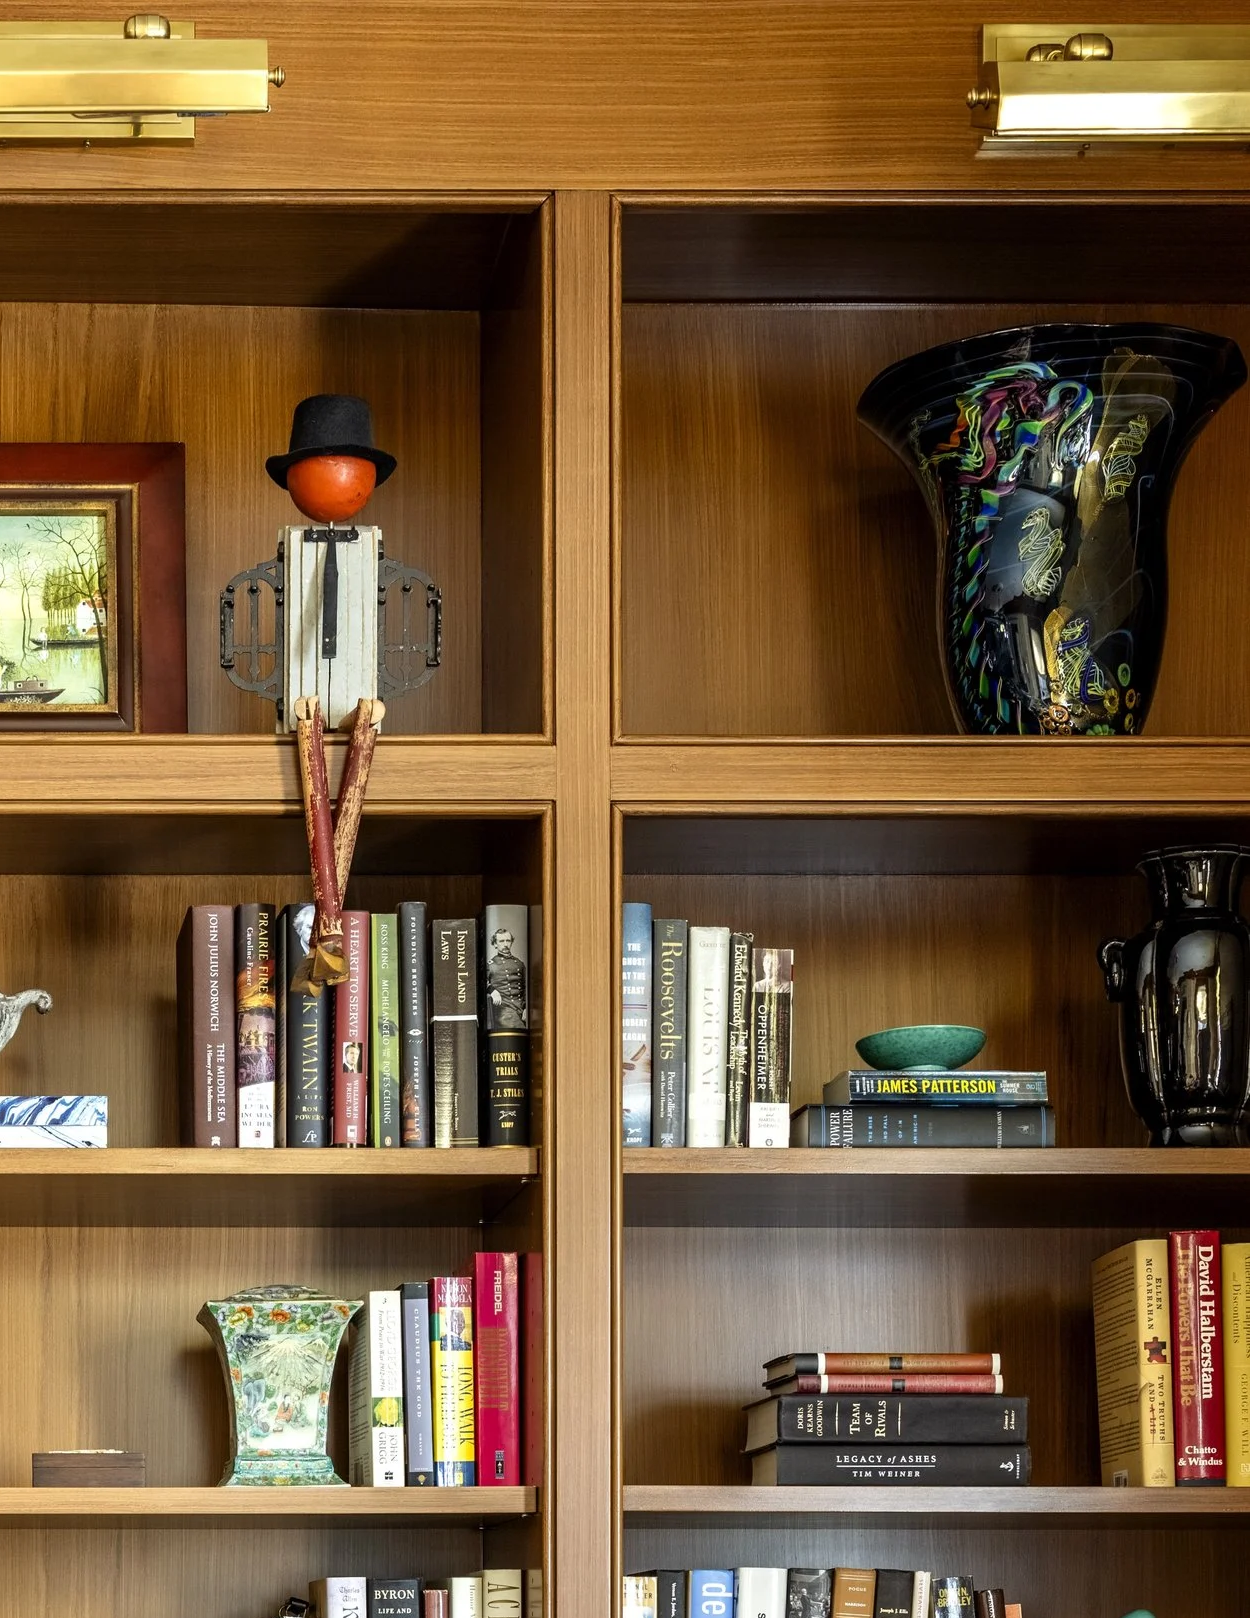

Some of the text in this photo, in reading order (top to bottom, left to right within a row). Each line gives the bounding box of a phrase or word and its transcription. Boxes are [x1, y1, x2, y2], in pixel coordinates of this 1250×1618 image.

[258, 912, 269, 999] PRAIRIE FIRES
[440, 930, 451, 961] LAWS
[457, 930, 468, 1004] INDIAN LAND
[208, 913, 219, 1032] JOHN JULIUS NORWICH
[729, 944, 748, 1029] Edward Kennedy
[381, 980, 390, 1047] MICHELANGELO
[302, 1019, 318, 1091] TWAIN
[757, 1005, 767, 1091] OPPENHEIMER
[217, 1043, 226, 1123] THE MIDDLE SEA
[877, 1080, 918, 1094] JAMES
[921, 1079, 997, 1094] PATTERSON
[830, 1111, 840, 1146] POWER
[494, 1270, 503, 1315] FREIDEL
[1198, 1245, 1216, 1399] David Halberstam
[850, 1403, 861, 1434] TEAM
[875, 1400, 887, 1438] RIVALS
[836, 1455, 937, 1464] LEGACY of ASHES
[1185, 1446, 1217, 1455] Chatto
[374, 1589, 415, 1600] BYRON
[701, 1582, 733, 1615] de
